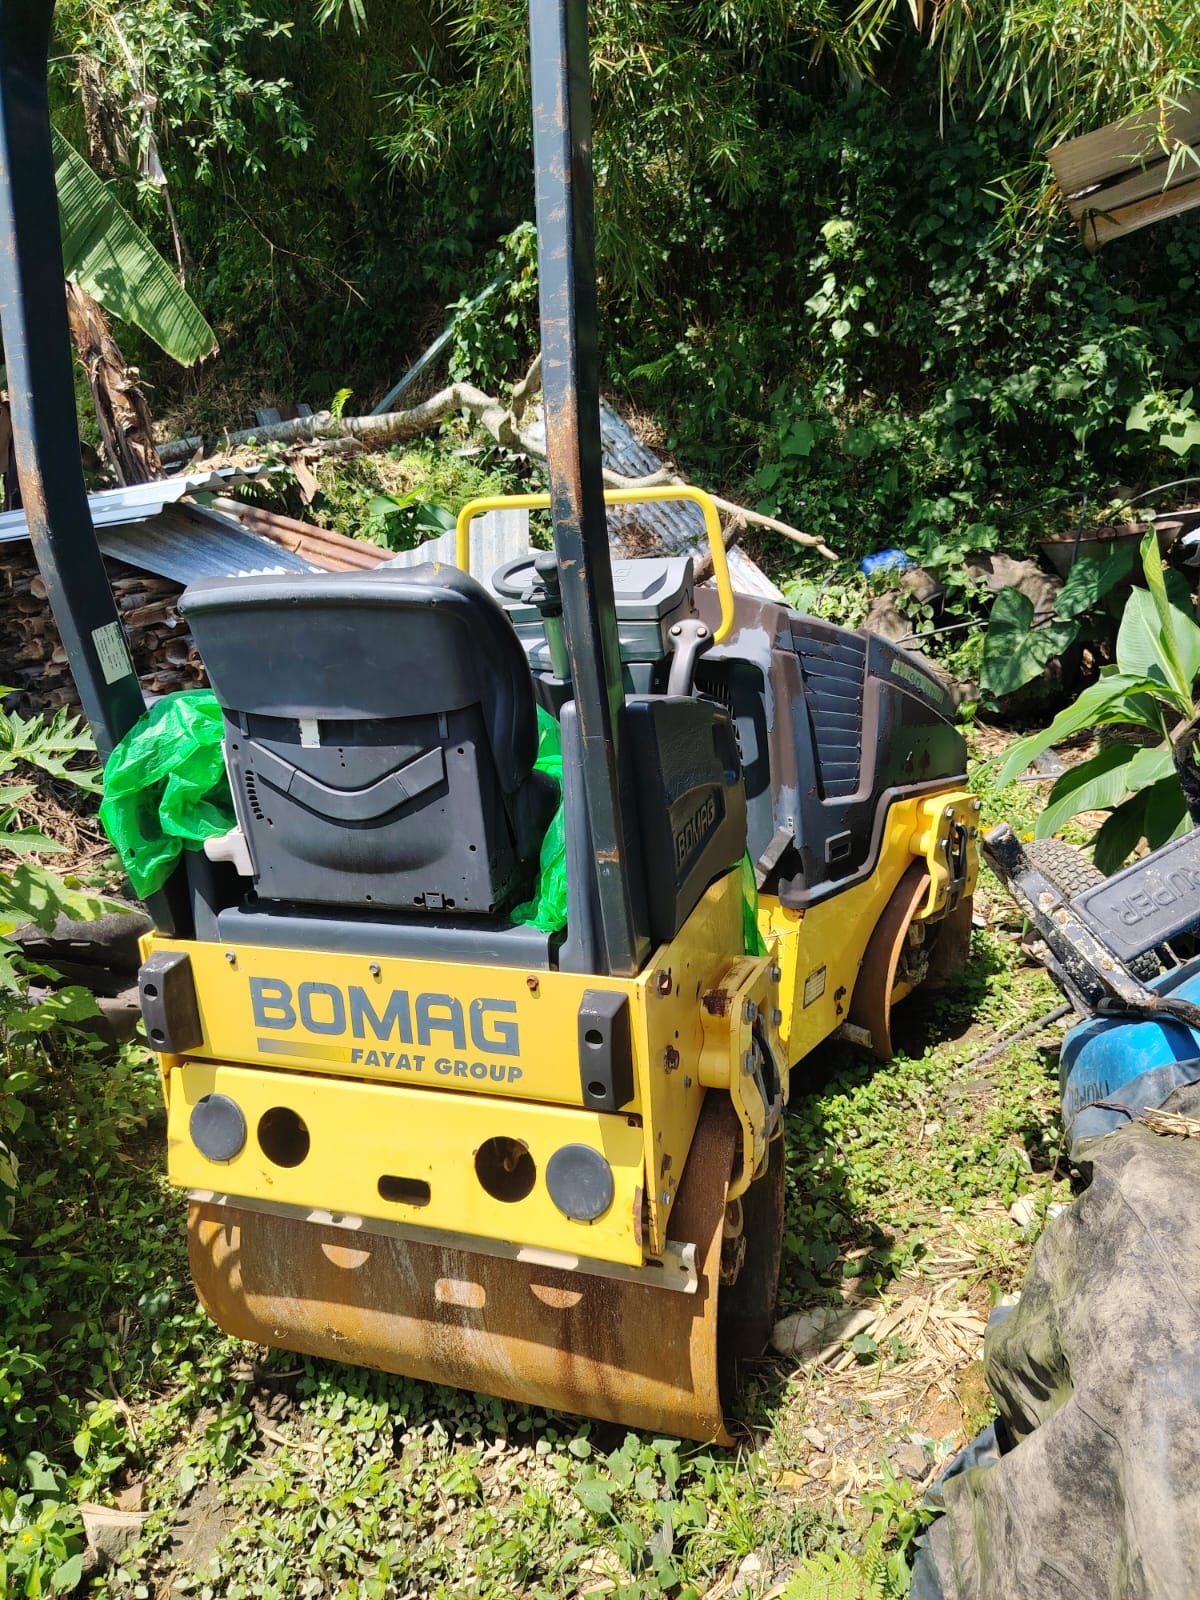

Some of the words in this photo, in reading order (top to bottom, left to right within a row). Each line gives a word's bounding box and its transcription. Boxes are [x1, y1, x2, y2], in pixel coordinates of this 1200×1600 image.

[676, 797, 715, 868] BOMAG
[248, 976, 521, 1057] BOMAG
[350, 1048, 426, 1072] FAYAT
[434, 1058, 524, 1084] GROUP
